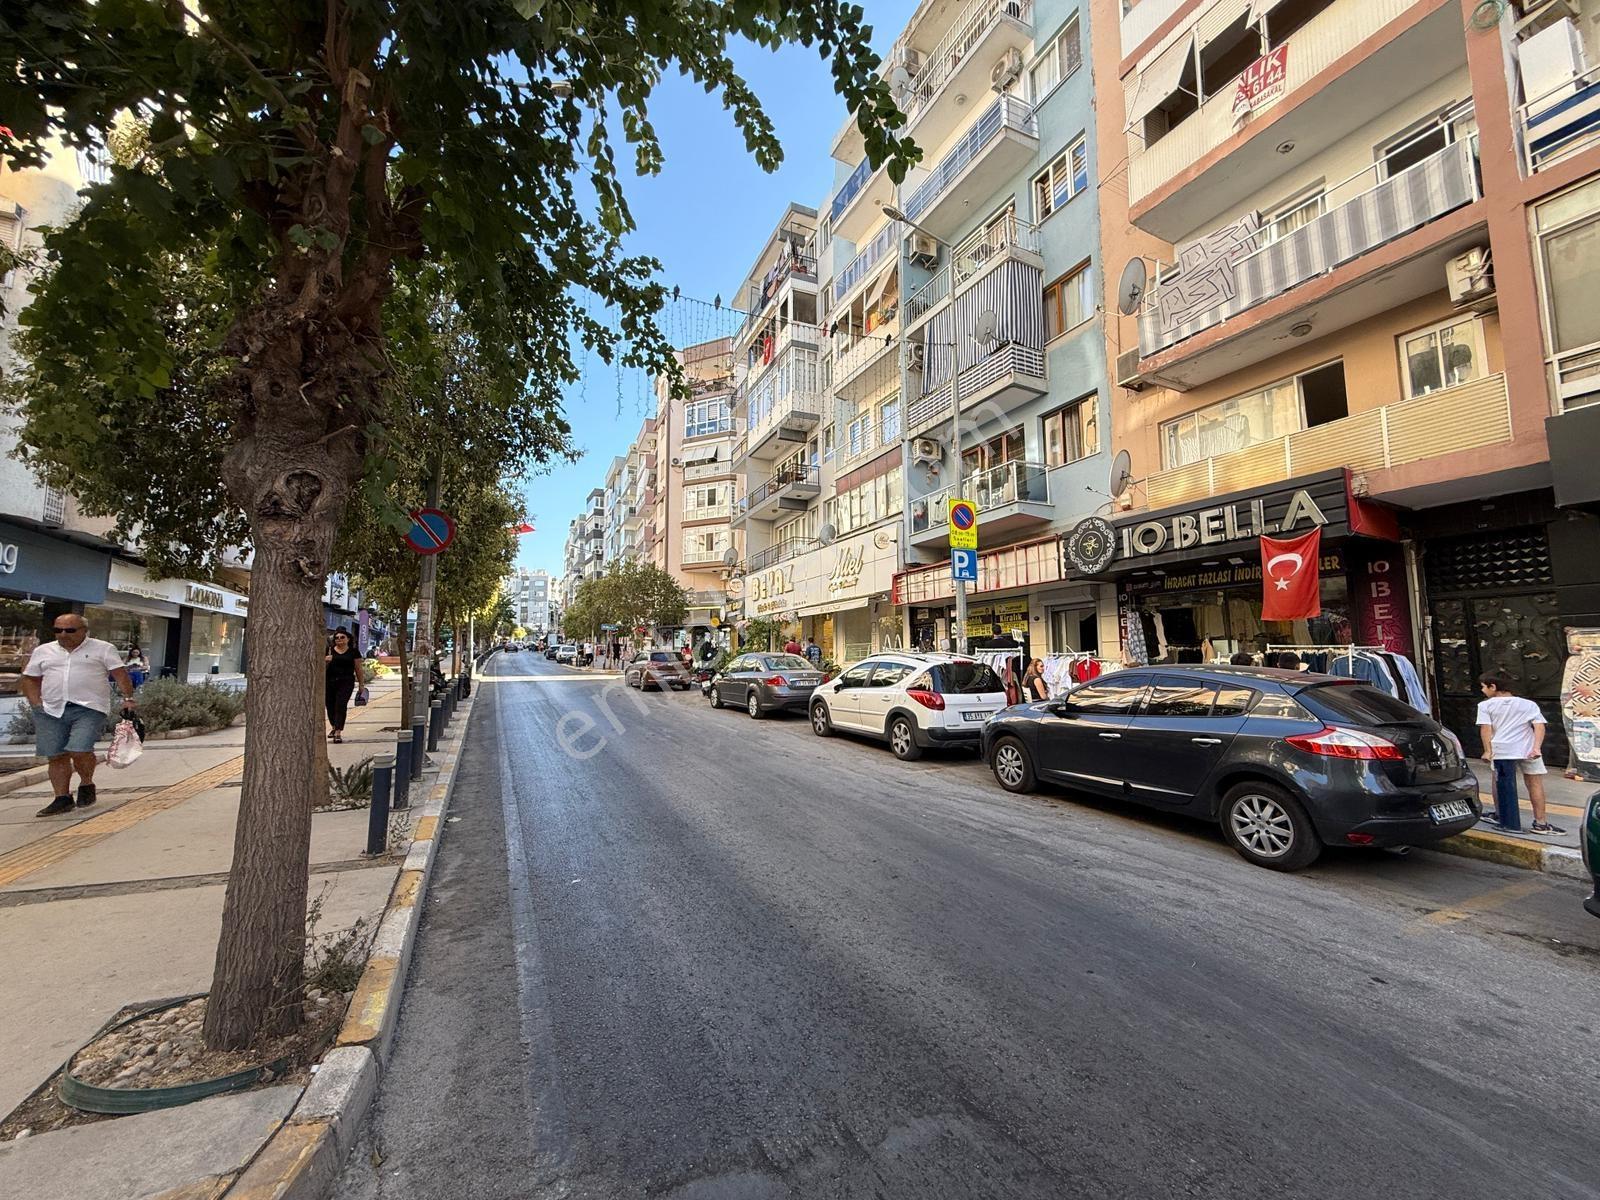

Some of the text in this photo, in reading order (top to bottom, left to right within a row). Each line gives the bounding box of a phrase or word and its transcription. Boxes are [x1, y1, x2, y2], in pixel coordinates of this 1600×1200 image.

[0, 541, 19, 574] g
[954, 551, 969, 578] P
[1164, 575, 1196, 589] İHRACAT
[1198, 570, 1231, 586] FAZLASI
[1319, 557, 1340, 571] LER
[751, 564, 794, 601] BEYAZ
[1432, 805, 1446, 819] 35
